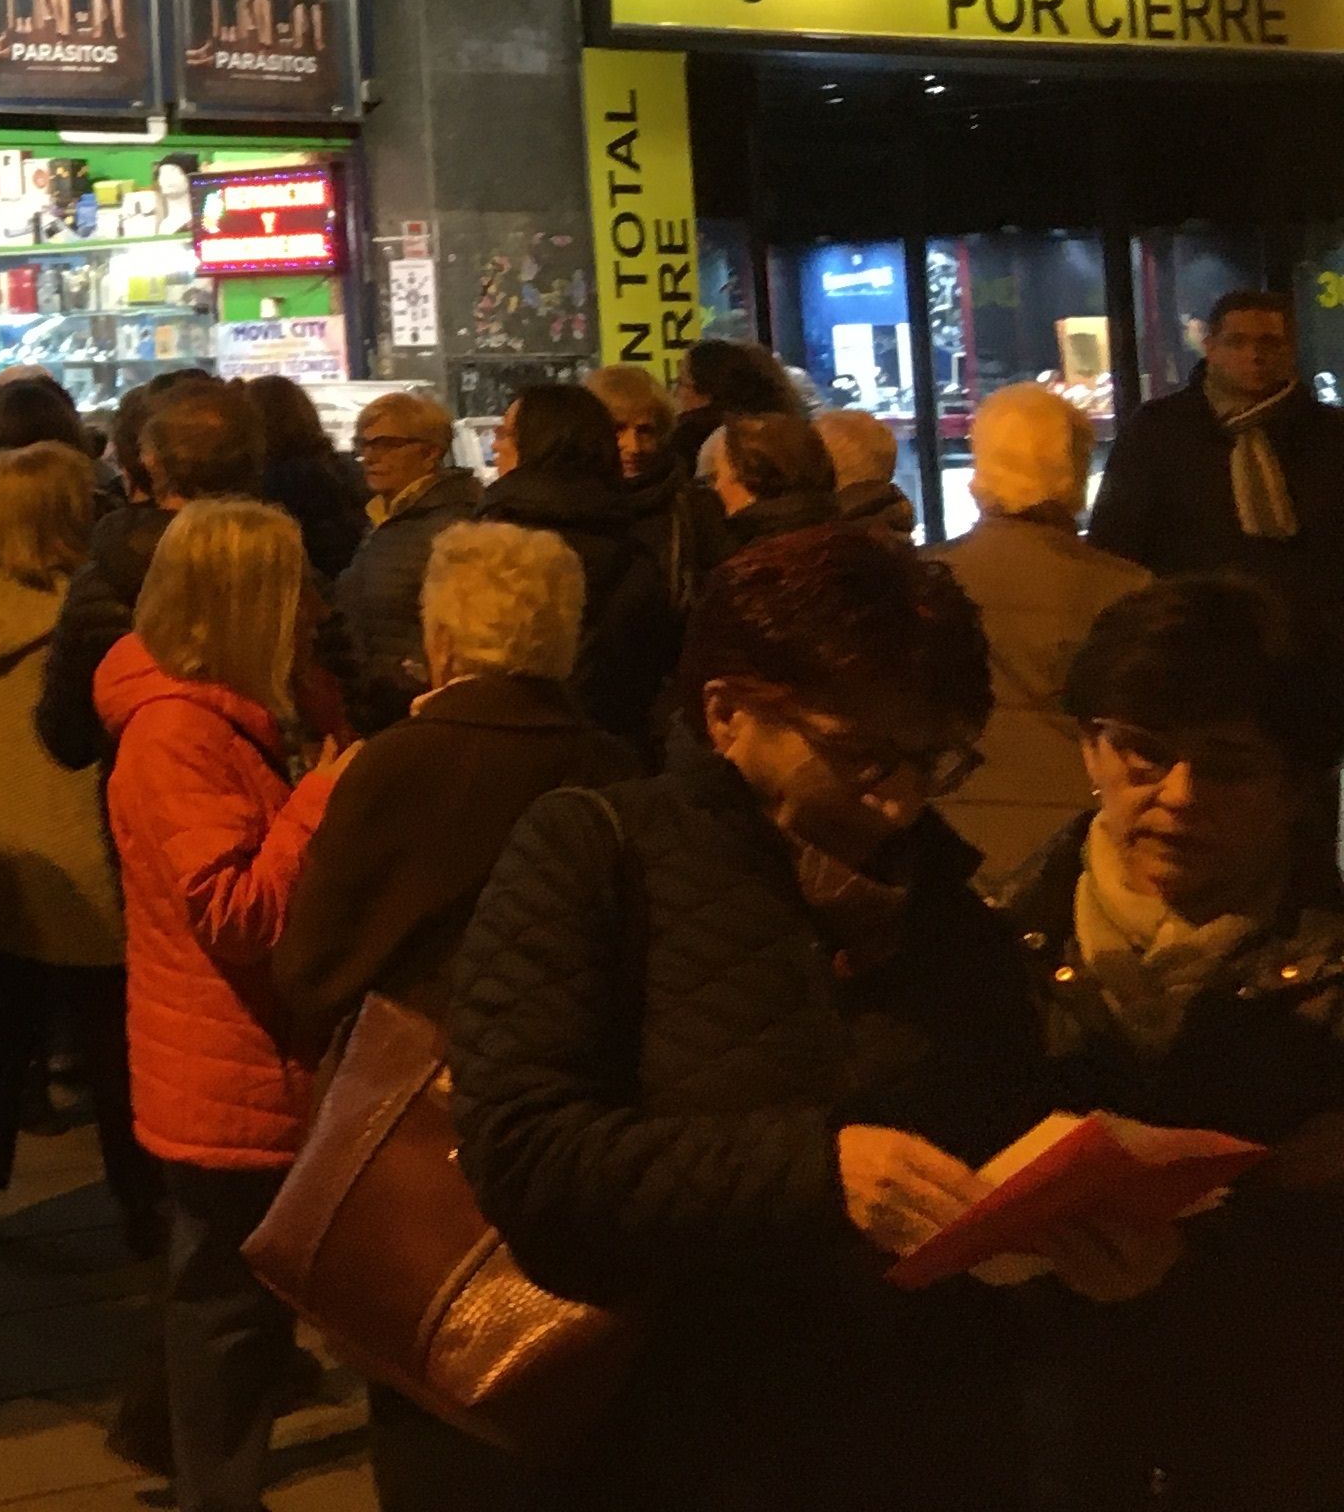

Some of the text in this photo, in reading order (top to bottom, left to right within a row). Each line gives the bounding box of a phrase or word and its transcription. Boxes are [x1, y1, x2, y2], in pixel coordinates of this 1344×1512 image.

[11, 40, 119, 64] PARÁSITOS
[604, 89, 649, 299] TOTAL
[232, 320, 328, 341] MOVIL CITY
[653, 218, 694, 390] ERRE
